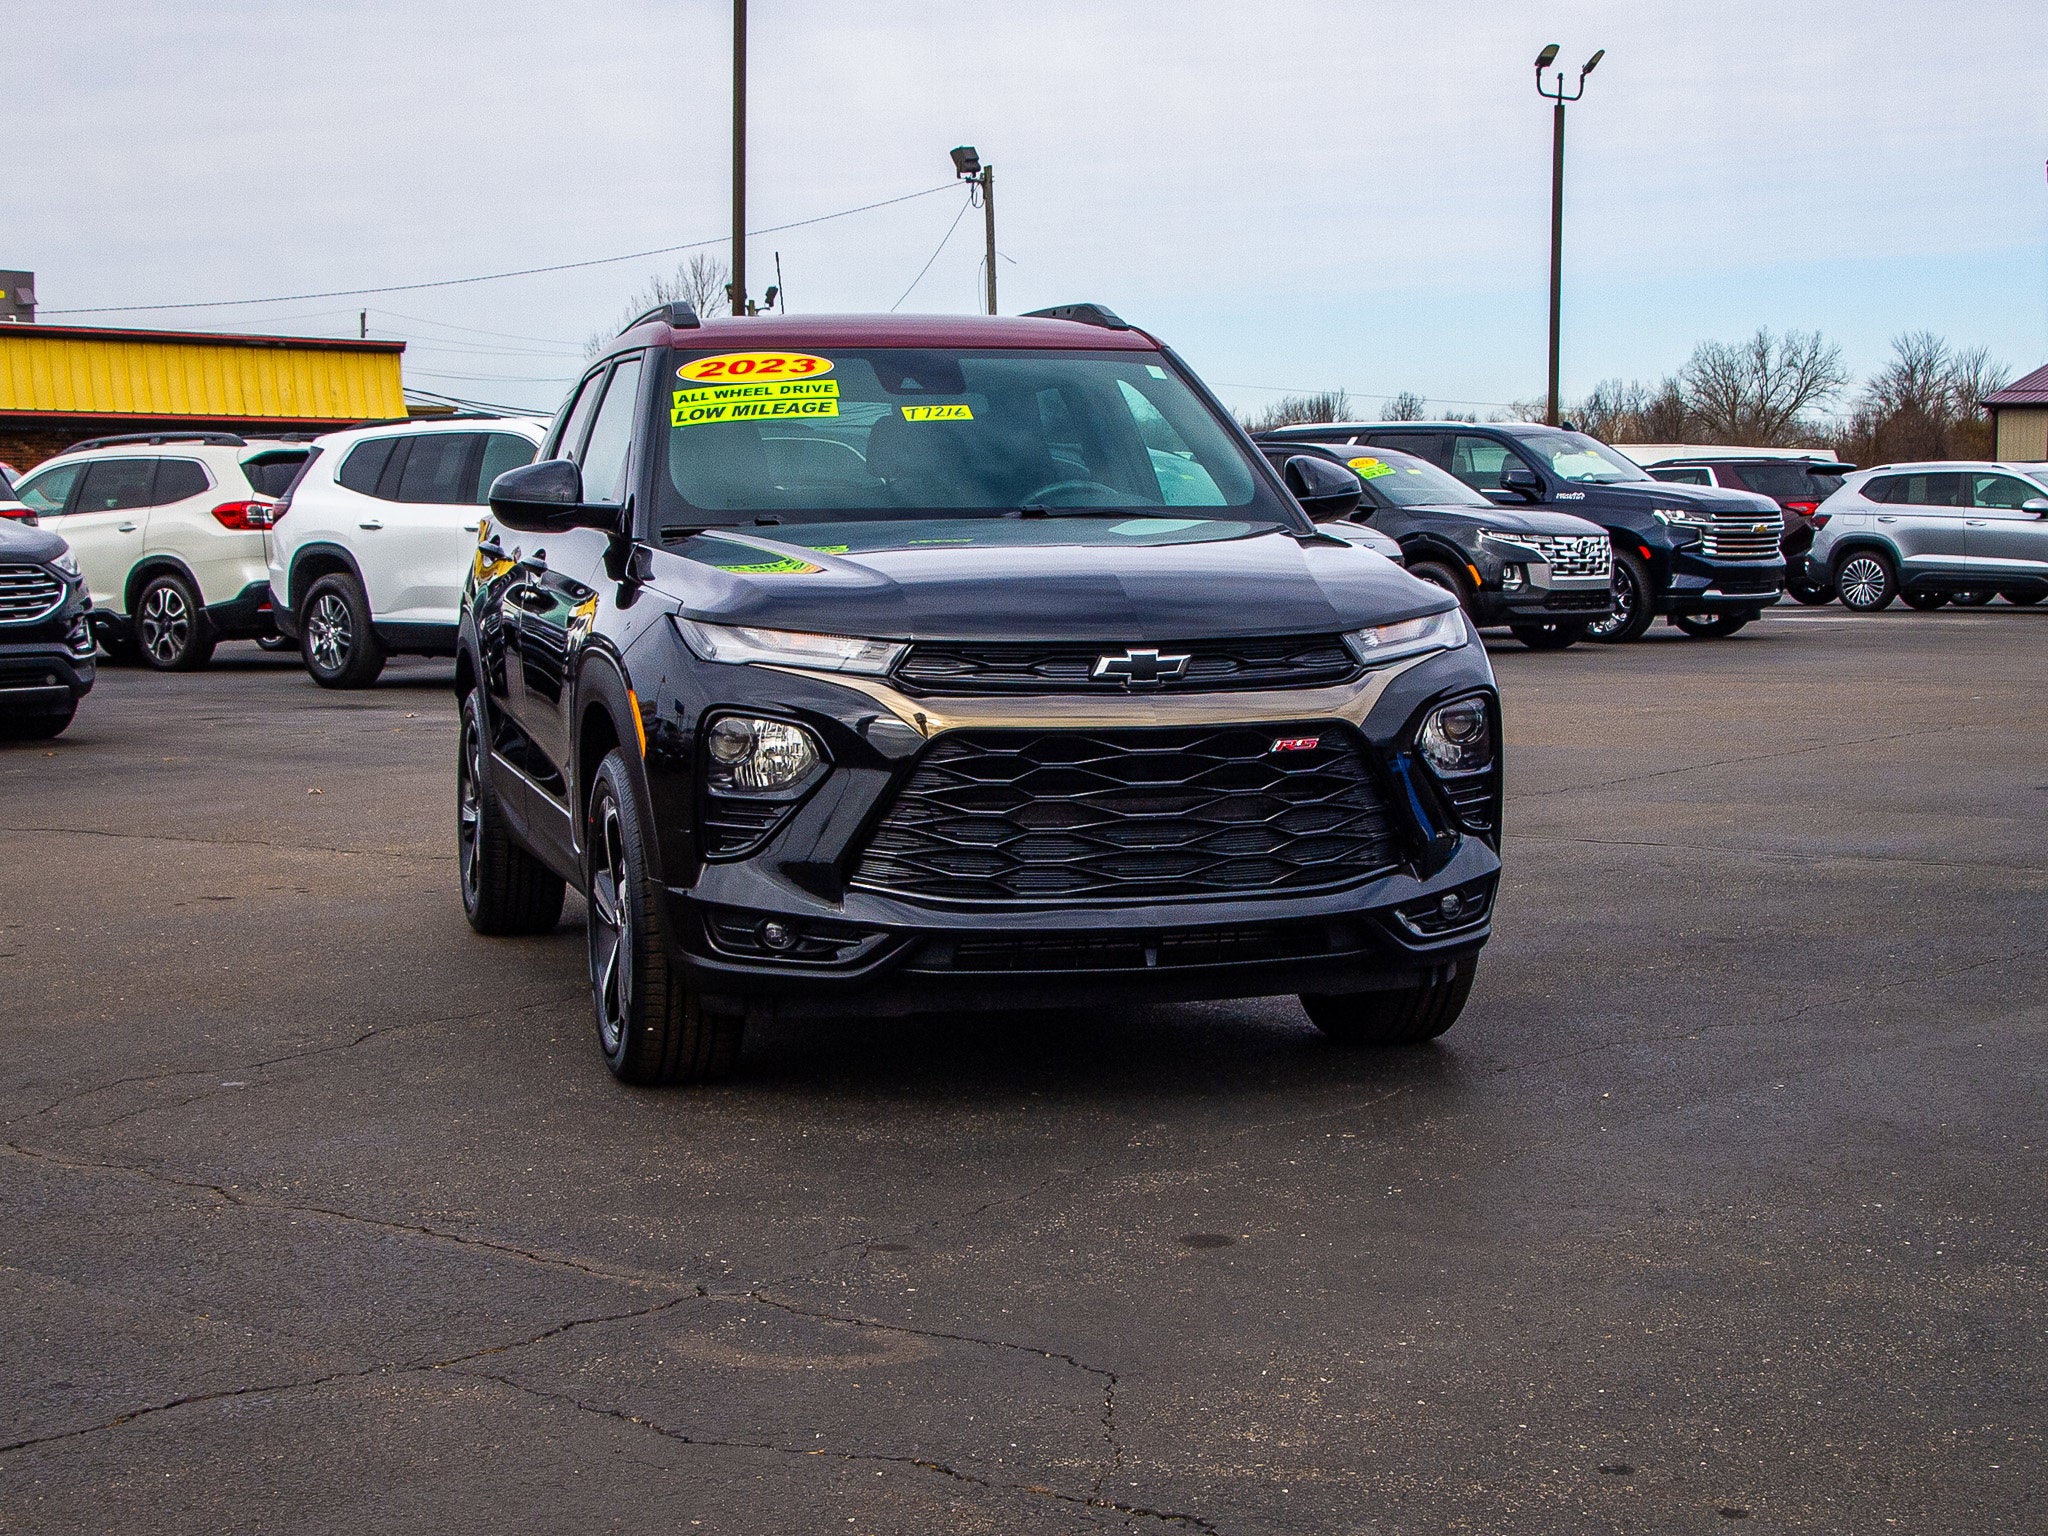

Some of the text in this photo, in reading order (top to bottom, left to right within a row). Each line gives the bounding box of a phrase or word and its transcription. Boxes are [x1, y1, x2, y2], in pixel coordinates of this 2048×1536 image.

[695, 358, 817, 378] 2023
[677, 383, 834, 404] ALL WHEEL DRIVE
[675, 401, 833, 423] LOW MILEAGE
[1270, 737, 1320, 753] RS
